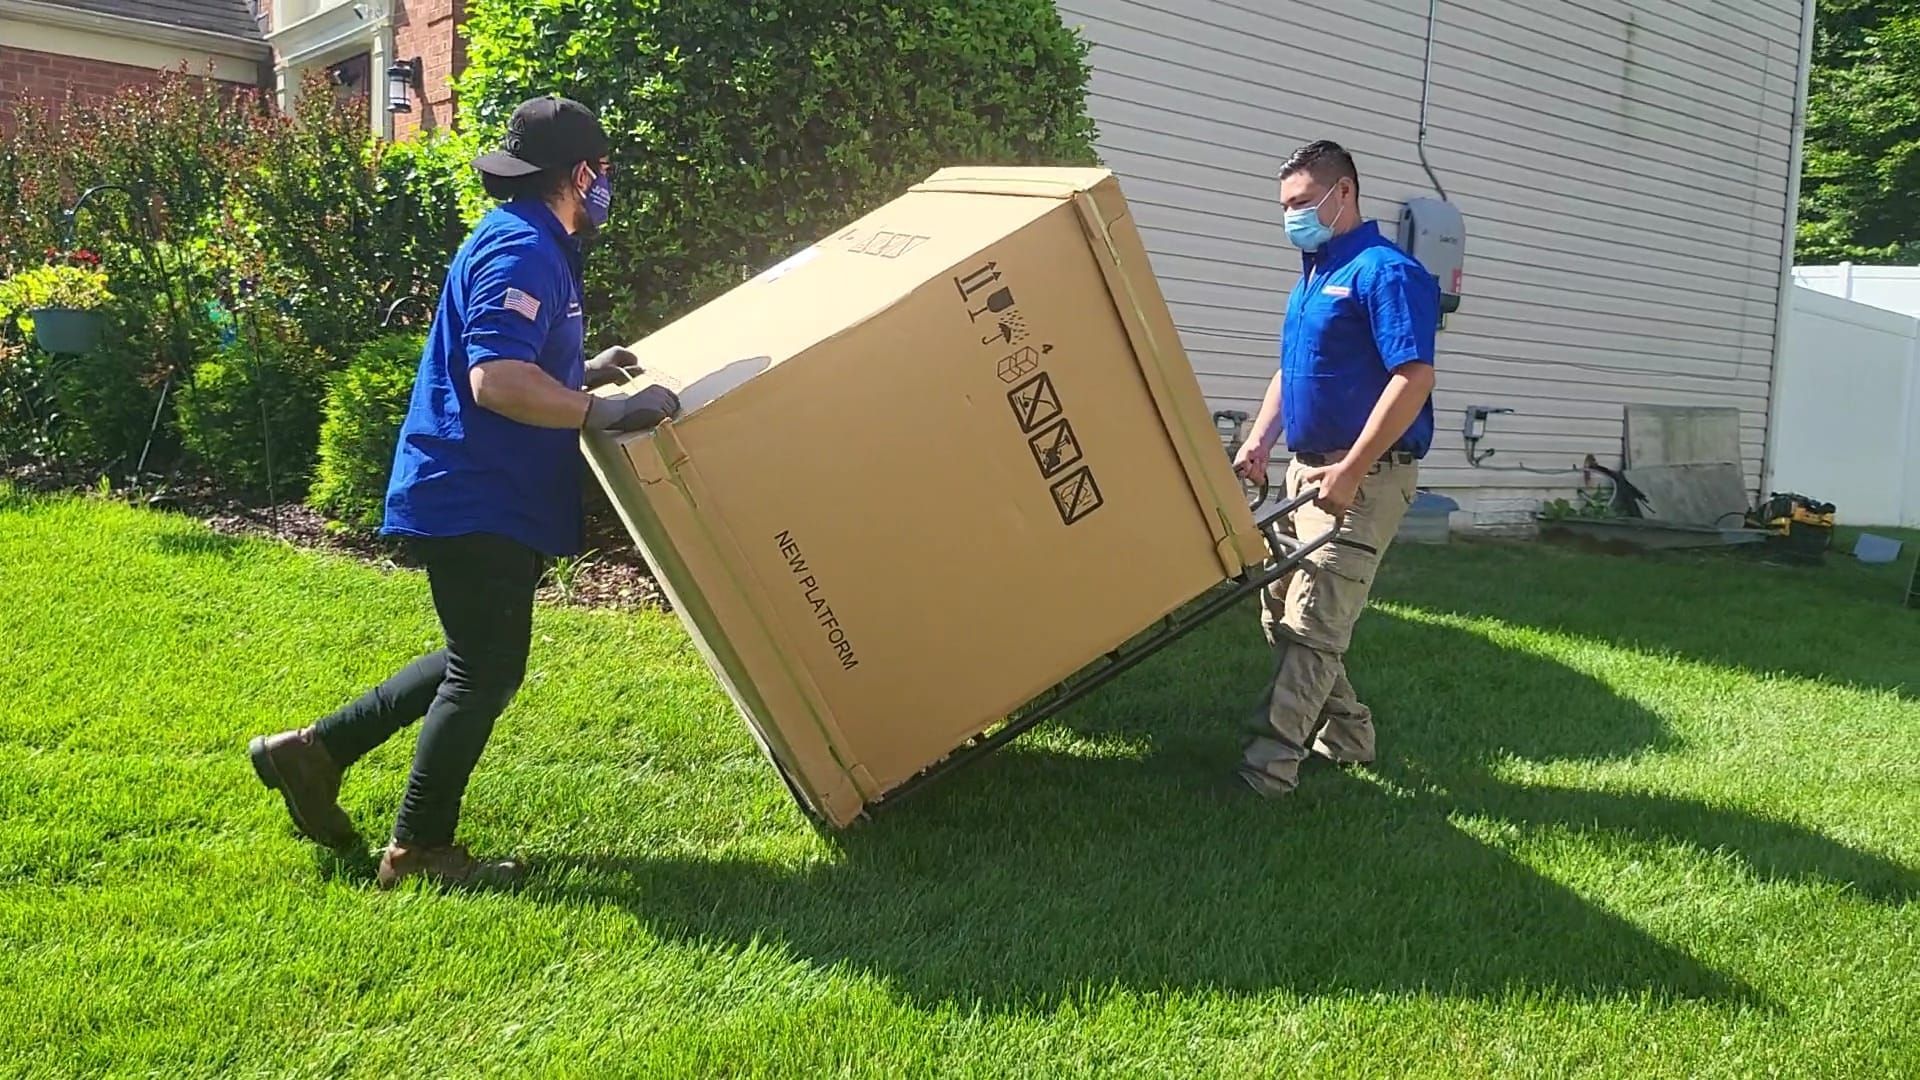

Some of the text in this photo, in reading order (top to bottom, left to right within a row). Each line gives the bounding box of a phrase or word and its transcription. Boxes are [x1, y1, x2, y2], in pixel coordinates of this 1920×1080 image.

[1041, 344, 1054, 355] 4
[774, 530, 859, 670] NEW PLATFORM
